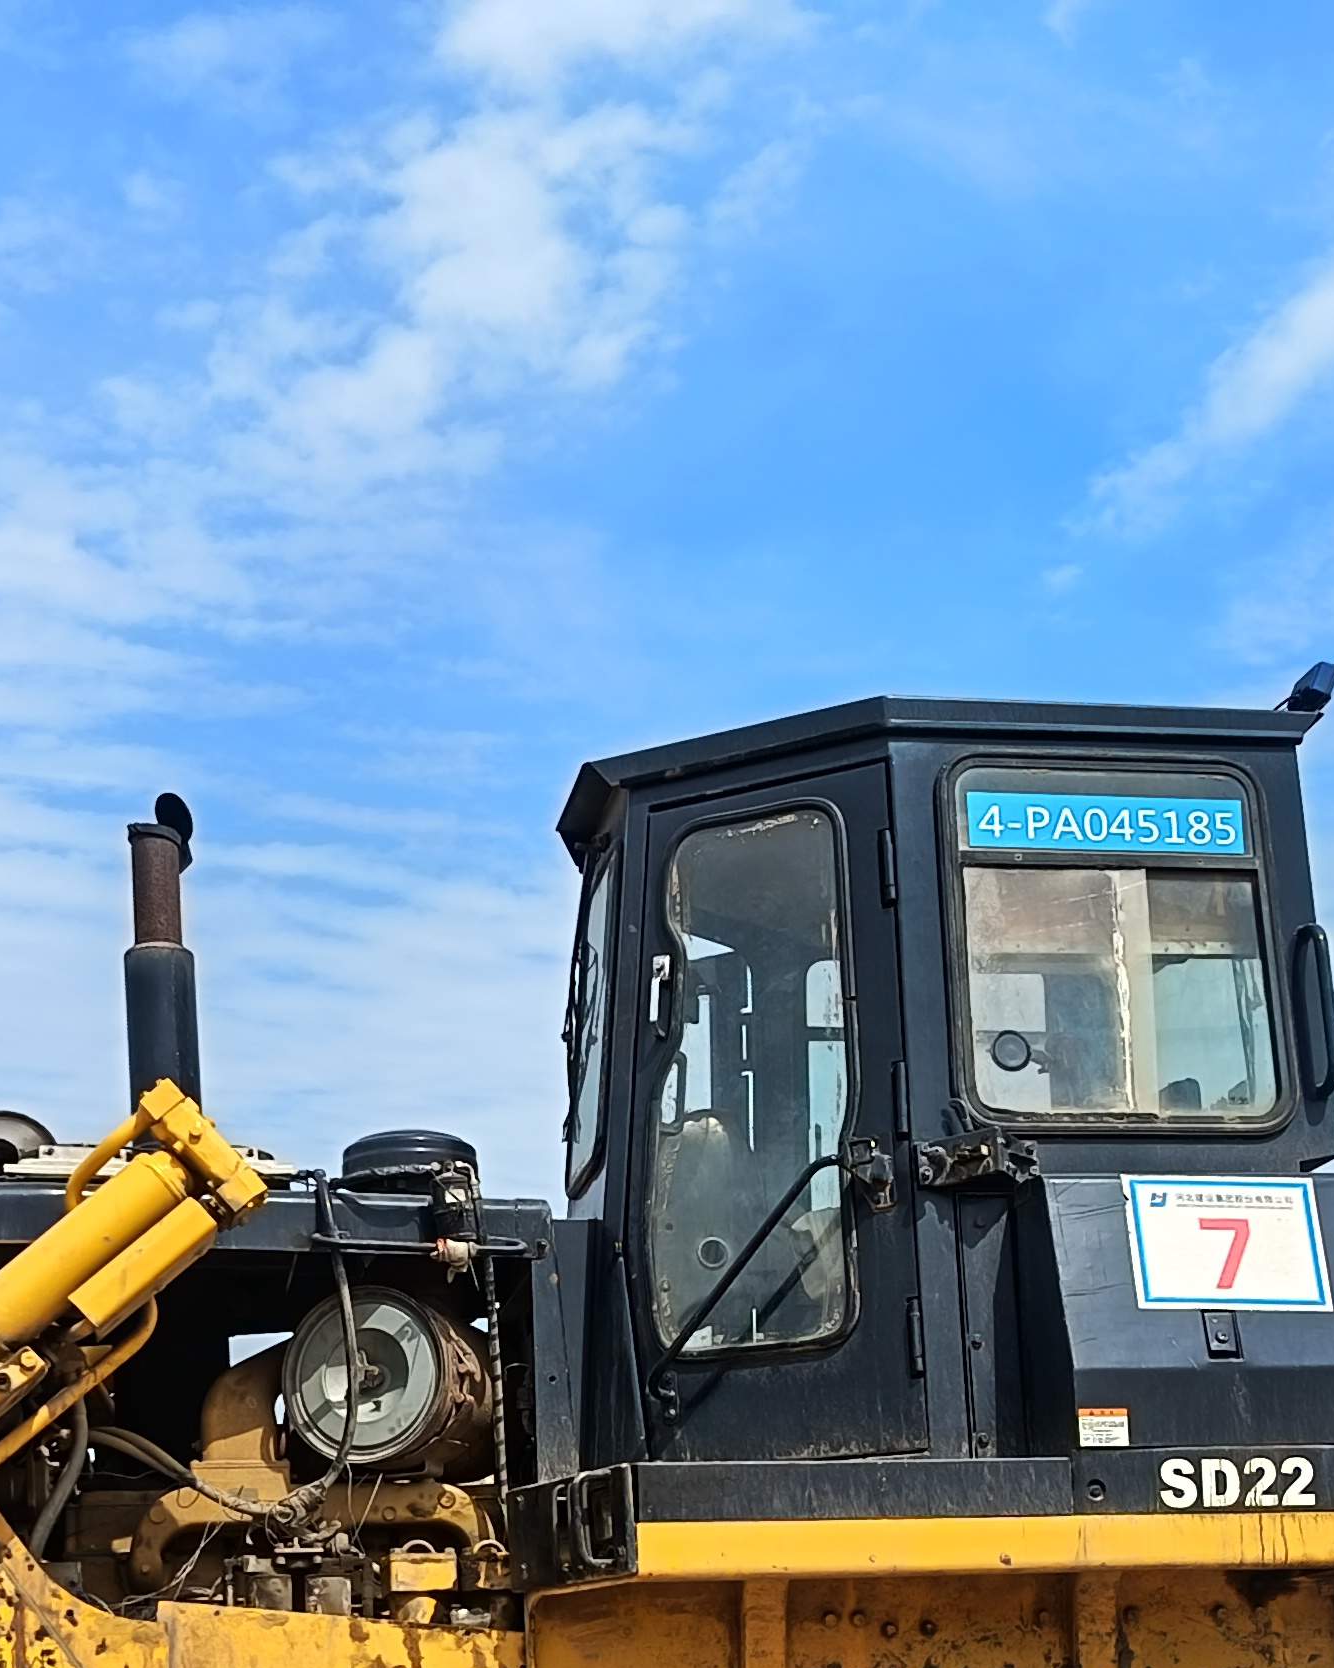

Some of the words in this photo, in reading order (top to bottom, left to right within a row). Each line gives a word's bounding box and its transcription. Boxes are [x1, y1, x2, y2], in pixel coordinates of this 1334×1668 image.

[978, 804, 1237, 846] 4-PA045185
[1199, 1218, 1250, 1289] 7
[1160, 1457, 1316, 1509] SD22
